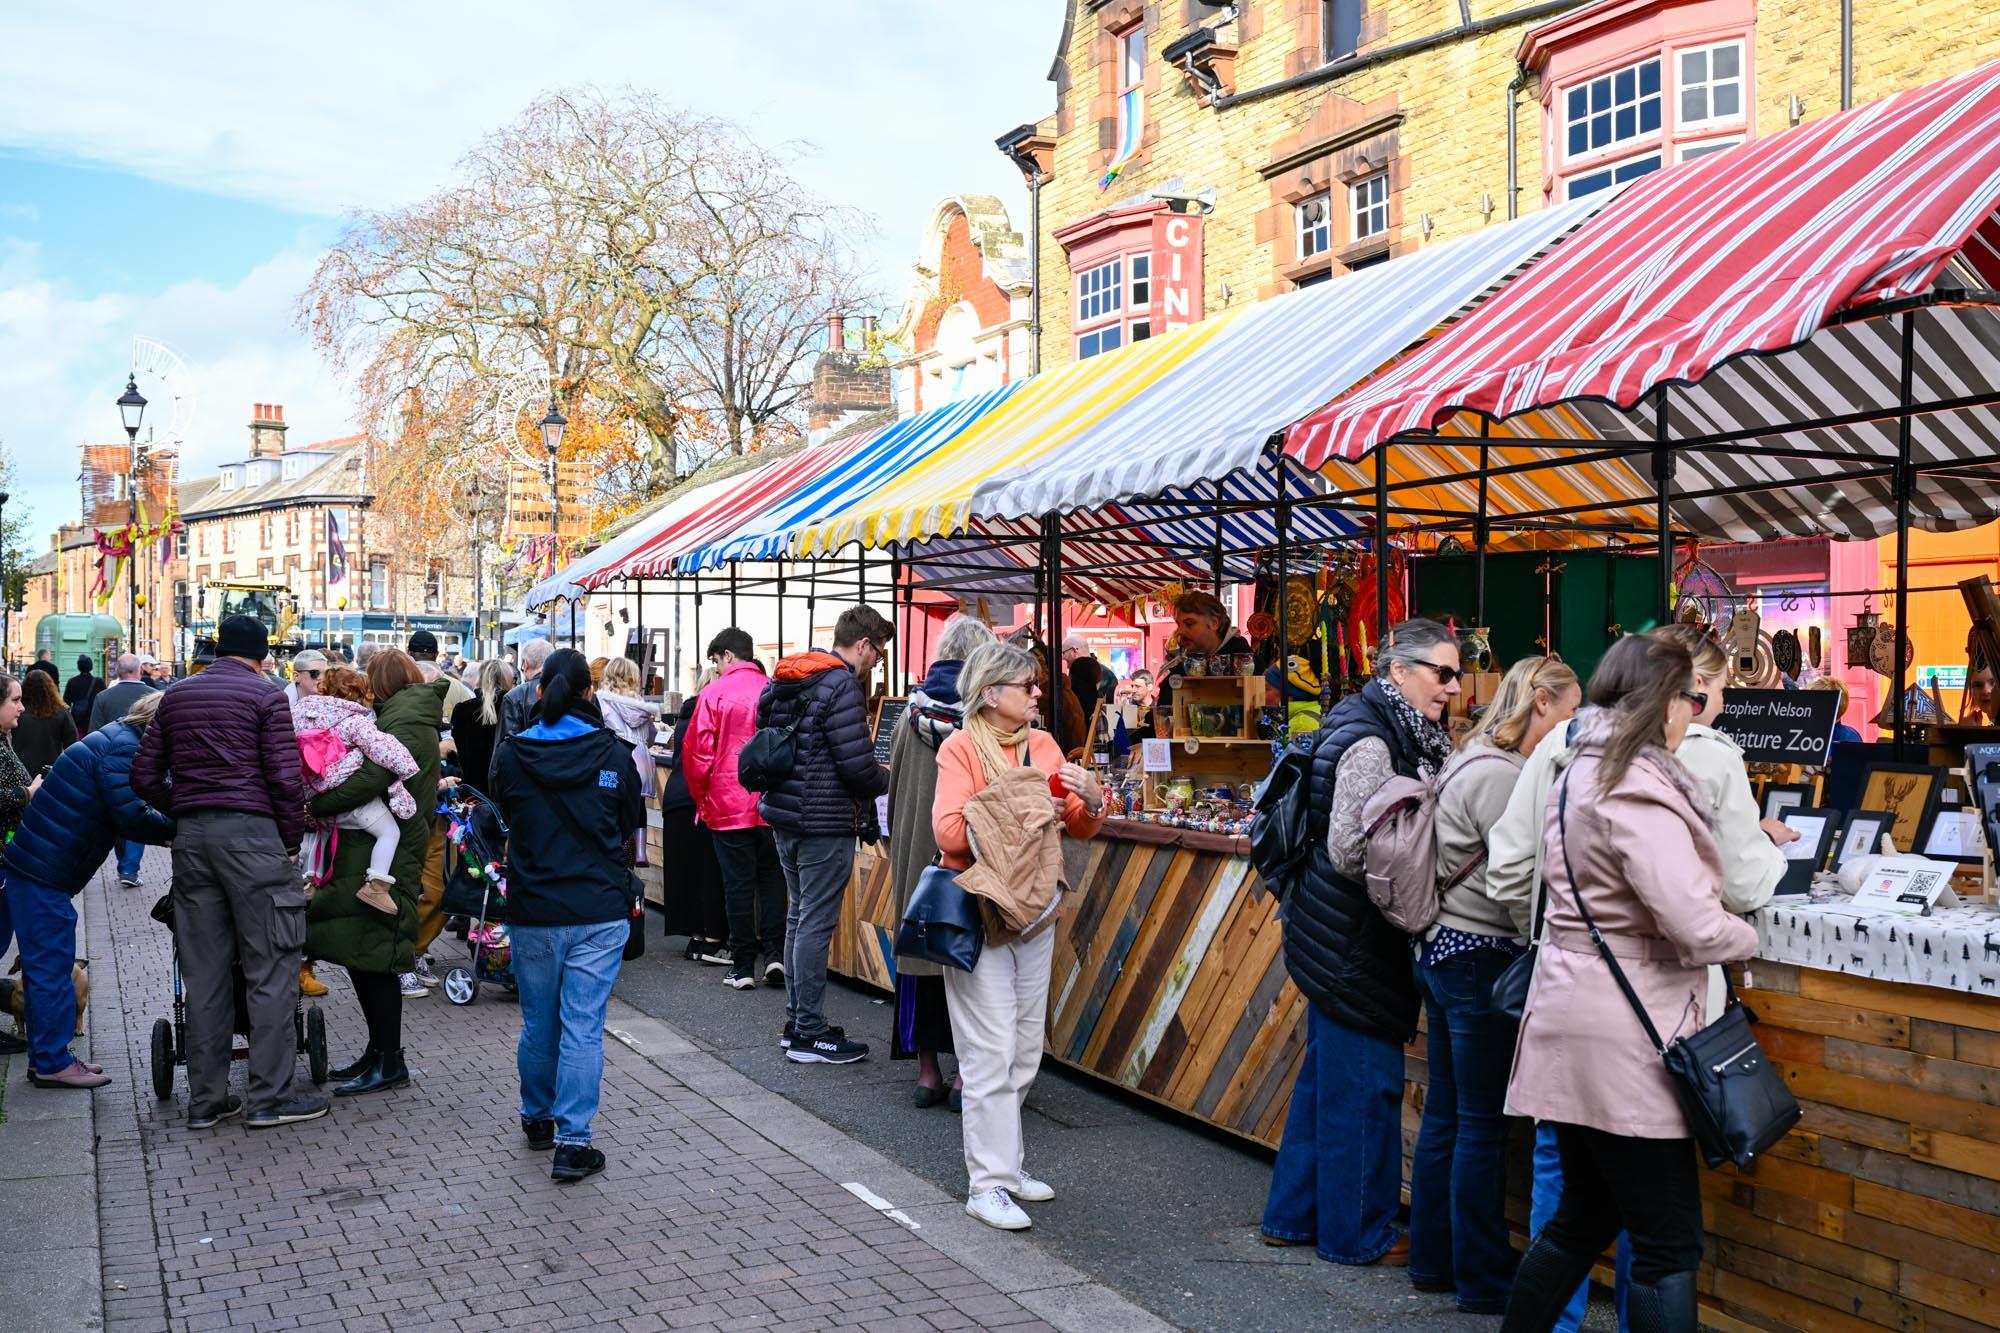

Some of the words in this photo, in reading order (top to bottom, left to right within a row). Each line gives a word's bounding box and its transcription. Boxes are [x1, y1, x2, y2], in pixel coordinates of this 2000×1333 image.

[417, 621, 442, 631] Properties
[1935, 667, 1948, 677] Fire
[1724, 700, 1765, 719] topher
[1768, 701, 1812, 718] Nelson
[1785, 728, 1825, 752] Zoo
[813, 1040, 838, 1052] HOKA
